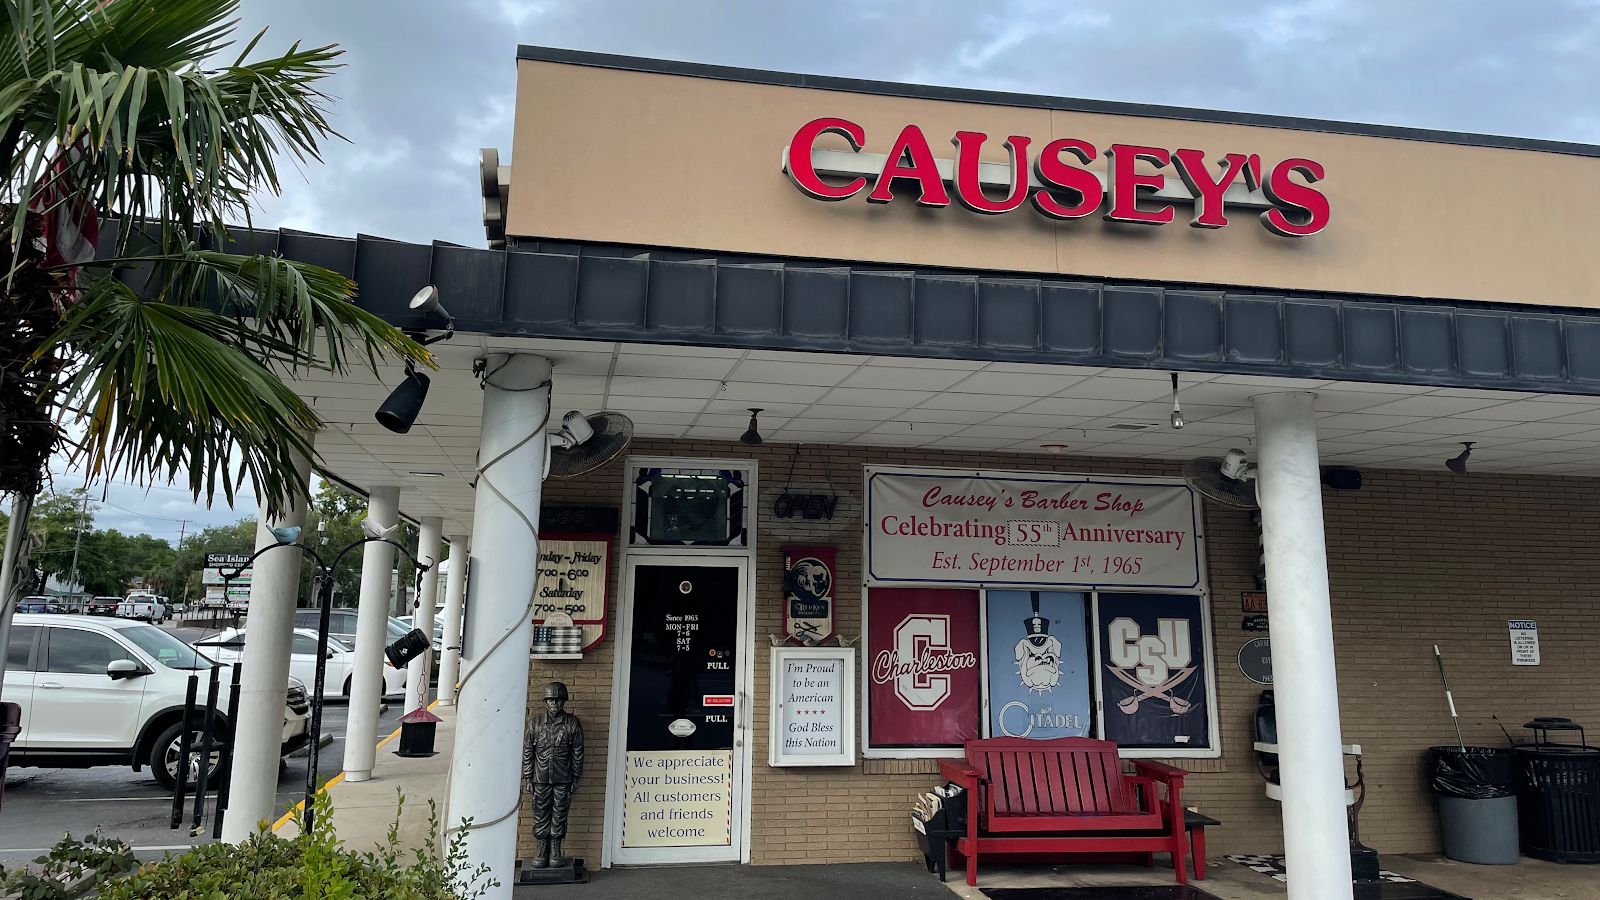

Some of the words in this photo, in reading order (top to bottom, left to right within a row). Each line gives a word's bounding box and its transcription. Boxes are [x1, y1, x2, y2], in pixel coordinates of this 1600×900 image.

[787, 117, 1330, 238] CAUSEY'S
[774, 494, 839, 520] OPEN
[922, 485, 1015, 512] Causey's
[1020, 490, 1089, 510] Barber
[1094, 492, 1145, 517] Shop
[881, 515, 1007, 545] Celebrating
[1062, 522, 1186, 551] Anniversary
[208, 554, 224, 562] Sea
[227, 554, 249, 562] Islan
[539, 551, 563, 564] nday
[932, 551, 962, 570] Est.
[969, 552, 1064, 576] September
[1102, 556, 1143, 575] 1965
[540, 587, 583, 600] Saturday
[665, 614, 683, 622] Since
[684, 614, 699, 622] 1965
[665, 623, 699, 631] MON-FRI
[1510, 621, 1536, 629] NOTICE
[1108, 616, 1192, 686] CSU
[707, 662, 729, 670] PULL
[787, 663, 803, 673] I'm
[806, 663, 835, 673] Proud
[872, 646, 976, 685] Charleston
[792, 678, 802, 688] to
[804, 678, 815, 688] be
[817, 680, 829, 688] an
[787, 693, 834, 703] American
[705, 715, 728, 723] PULL
[999, 700, 1084, 738] CITADEL
[788, 722, 809, 733] God
[811, 722, 834, 733] Bless
[785, 738, 802, 748] this
[804, 737, 836, 748] Nation
[633, 757, 653, 768] We
[657, 756, 725, 770] appreciate
[631, 775, 661, 788] your
[664, 773, 725, 785] business!
[633, 792, 650, 803] All
[654, 791, 722, 802] customers
[640, 809, 665, 820] and
[669, 808, 714, 820] friends
[647, 826, 706, 838] welcome
